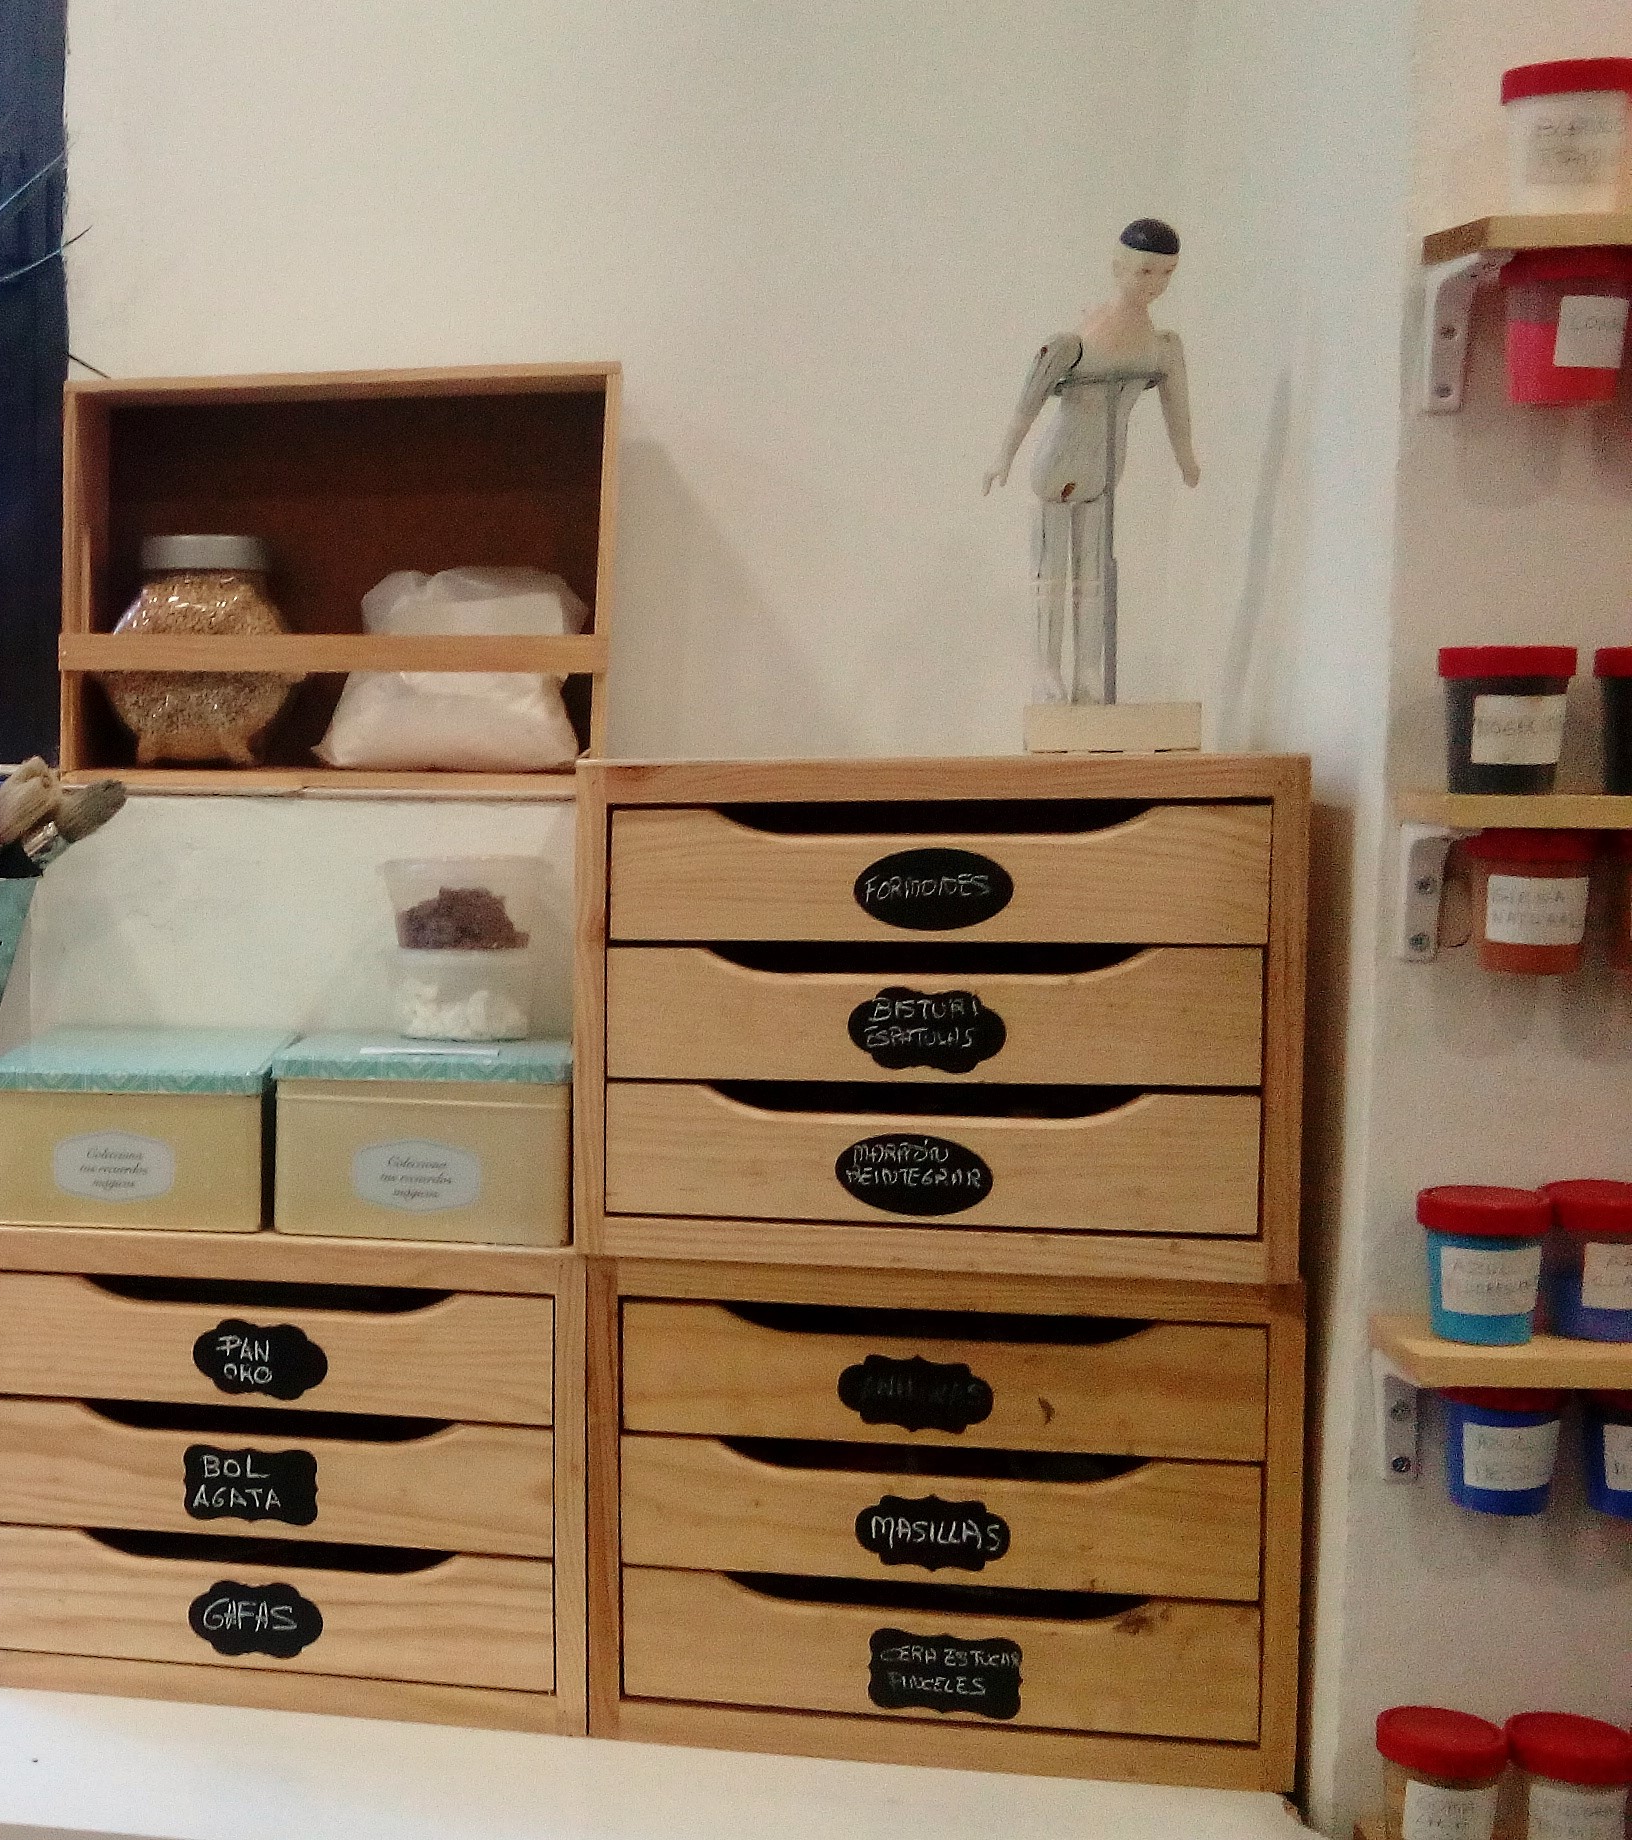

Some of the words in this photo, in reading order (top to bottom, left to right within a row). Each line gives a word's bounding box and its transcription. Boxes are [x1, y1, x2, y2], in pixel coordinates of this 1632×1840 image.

[216, 1334, 269, 1362] PAN
[202, 1454, 270, 1478] BOL
[193, 1484, 281, 1510] AGATA
[871, 1515, 1000, 1550] MASILLAS
[203, 1598, 298, 1632] GAFAS
